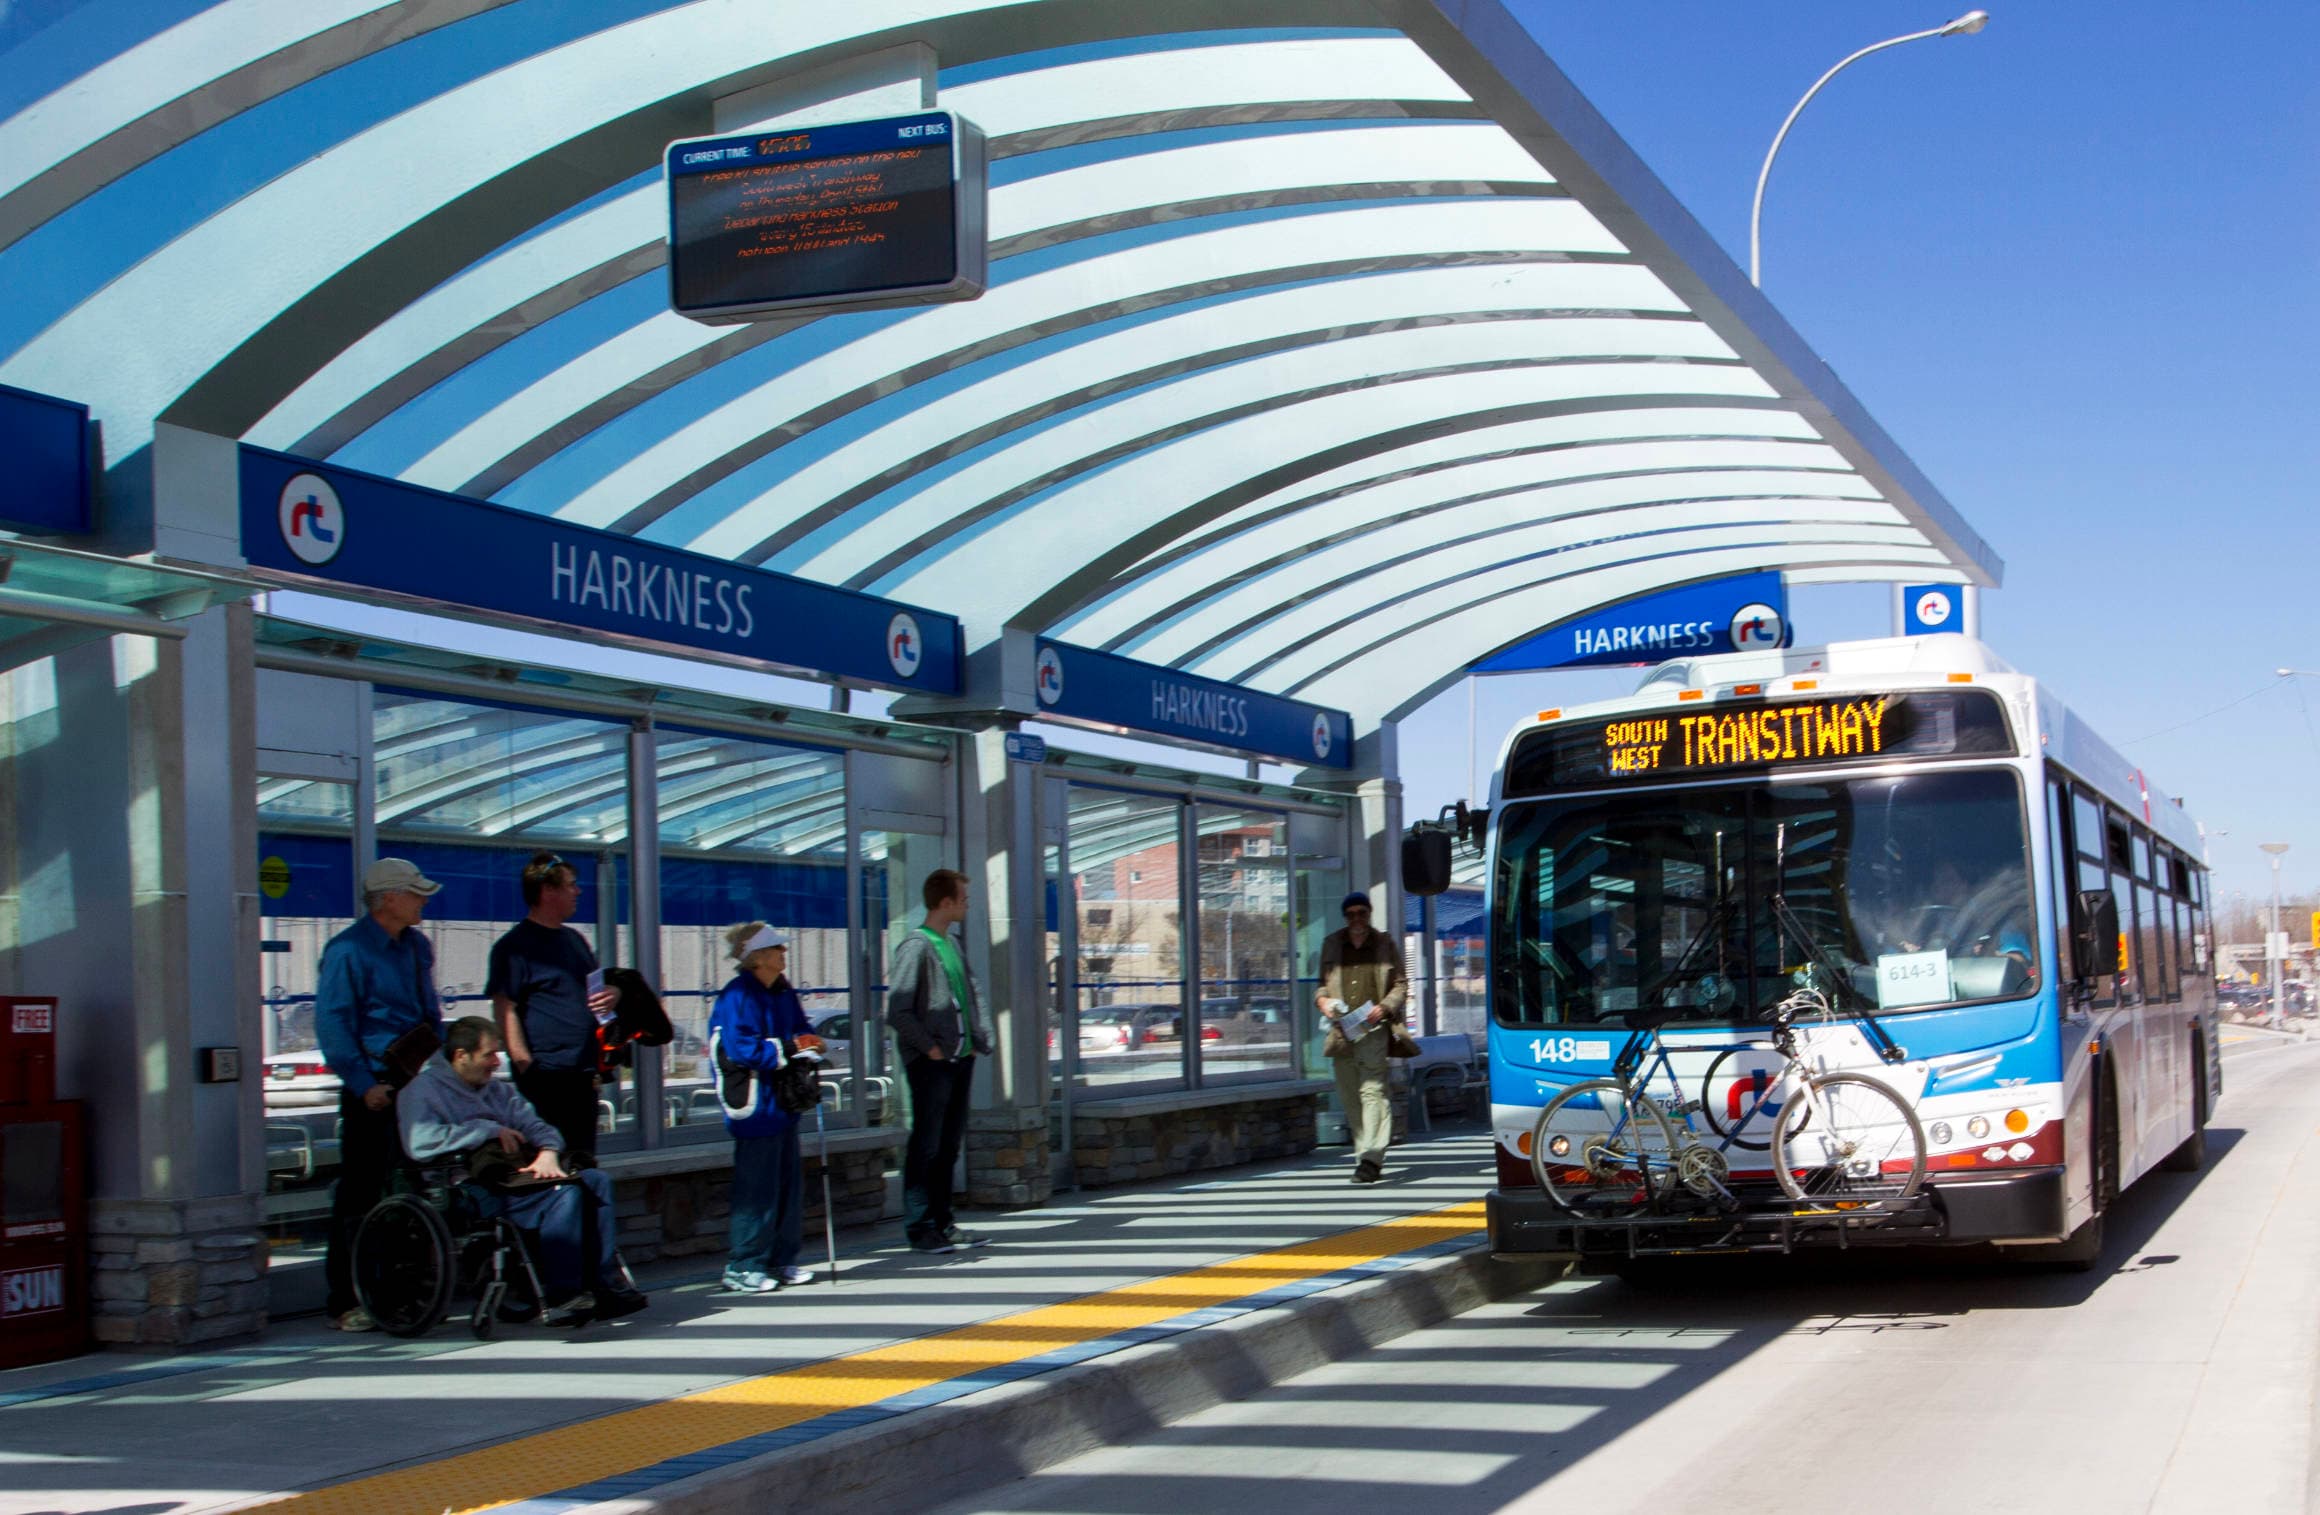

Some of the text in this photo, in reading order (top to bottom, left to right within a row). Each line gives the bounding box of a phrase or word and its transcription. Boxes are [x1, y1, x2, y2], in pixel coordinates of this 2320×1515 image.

[898, 122, 949, 138] NEXT BUS:
[682, 145, 752, 165] CURRENT TIME:
[551, 541, 754, 638] HARKNESS
[1573, 620, 1714, 656] HARKNESS
[1151, 679, 1249, 738] HARKNESS
[1605, 719, 1668, 746] SOUTH
[1679, 700, 1886, 766] TRANSITWAY
[1611, 745, 1663, 771] WEST
[1889, 962, 1937, 981] 614-3
[16, 1008, 48, 1029] FREE
[1529, 1037, 1576, 1063] 148
[10, 1268, 63, 1312] SUN
